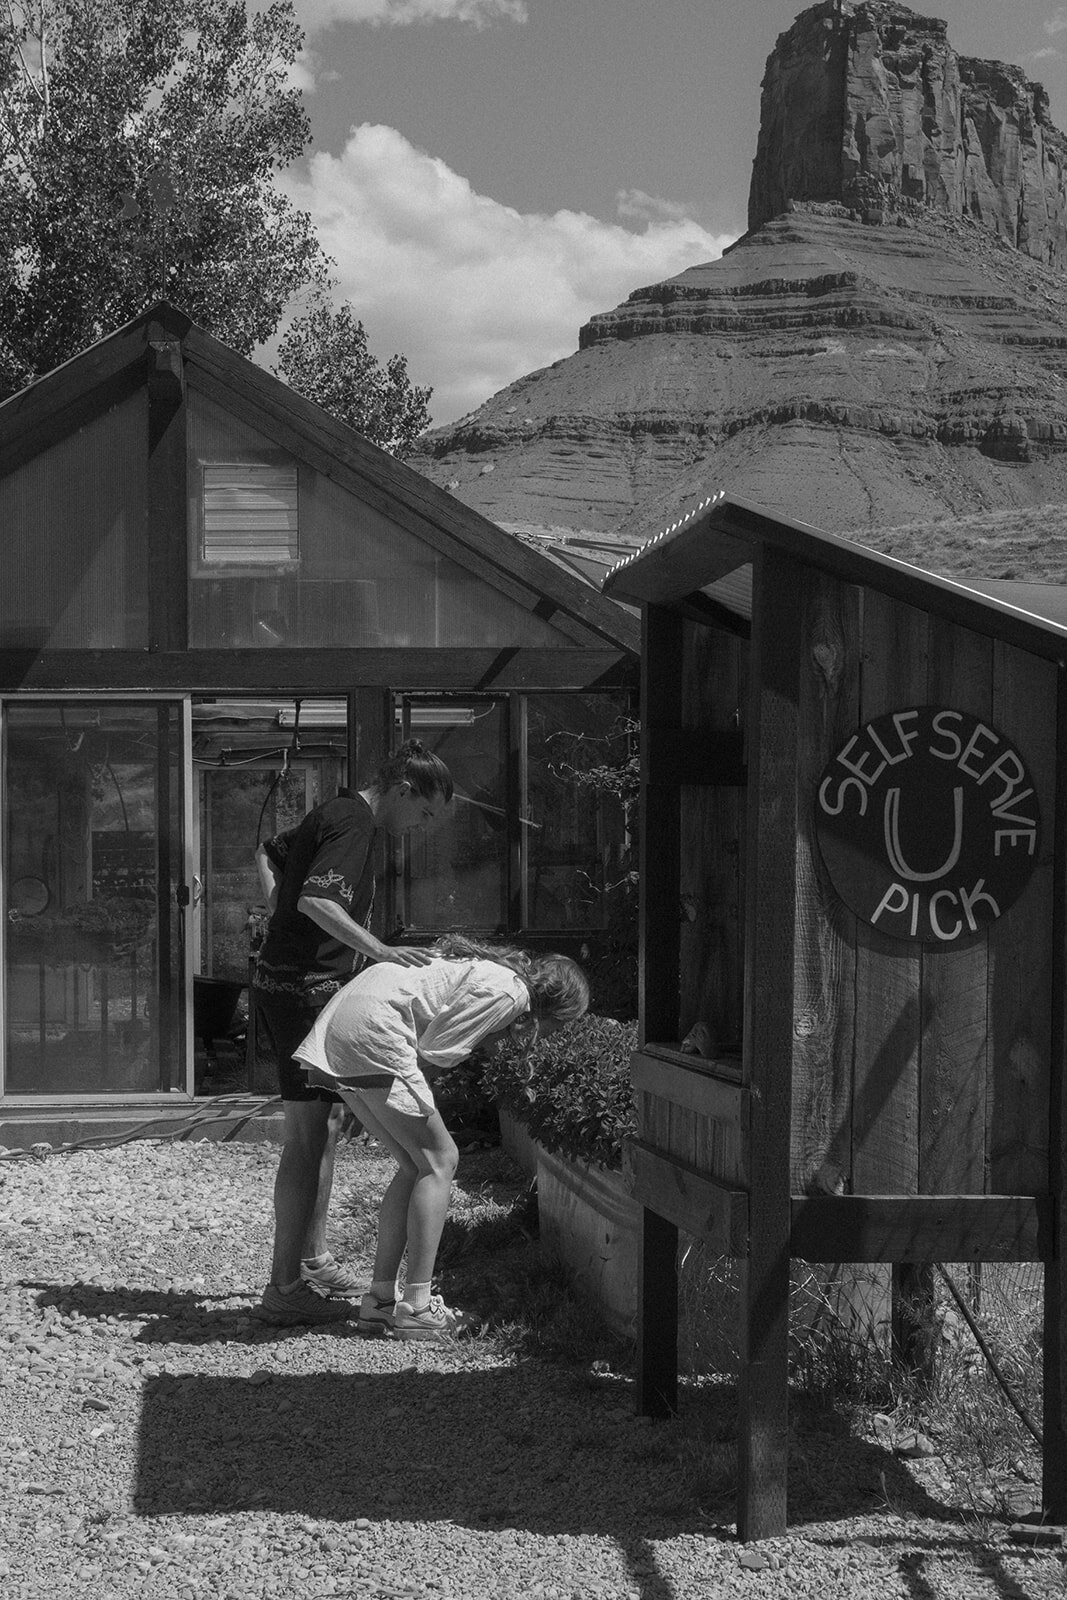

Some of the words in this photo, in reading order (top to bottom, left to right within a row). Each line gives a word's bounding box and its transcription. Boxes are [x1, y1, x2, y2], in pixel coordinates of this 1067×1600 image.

[819, 711, 919, 816] SELF
[929, 711, 1037, 856] SERVE
[884, 786, 964, 882] U
[870, 878, 1001, 940] PICK
